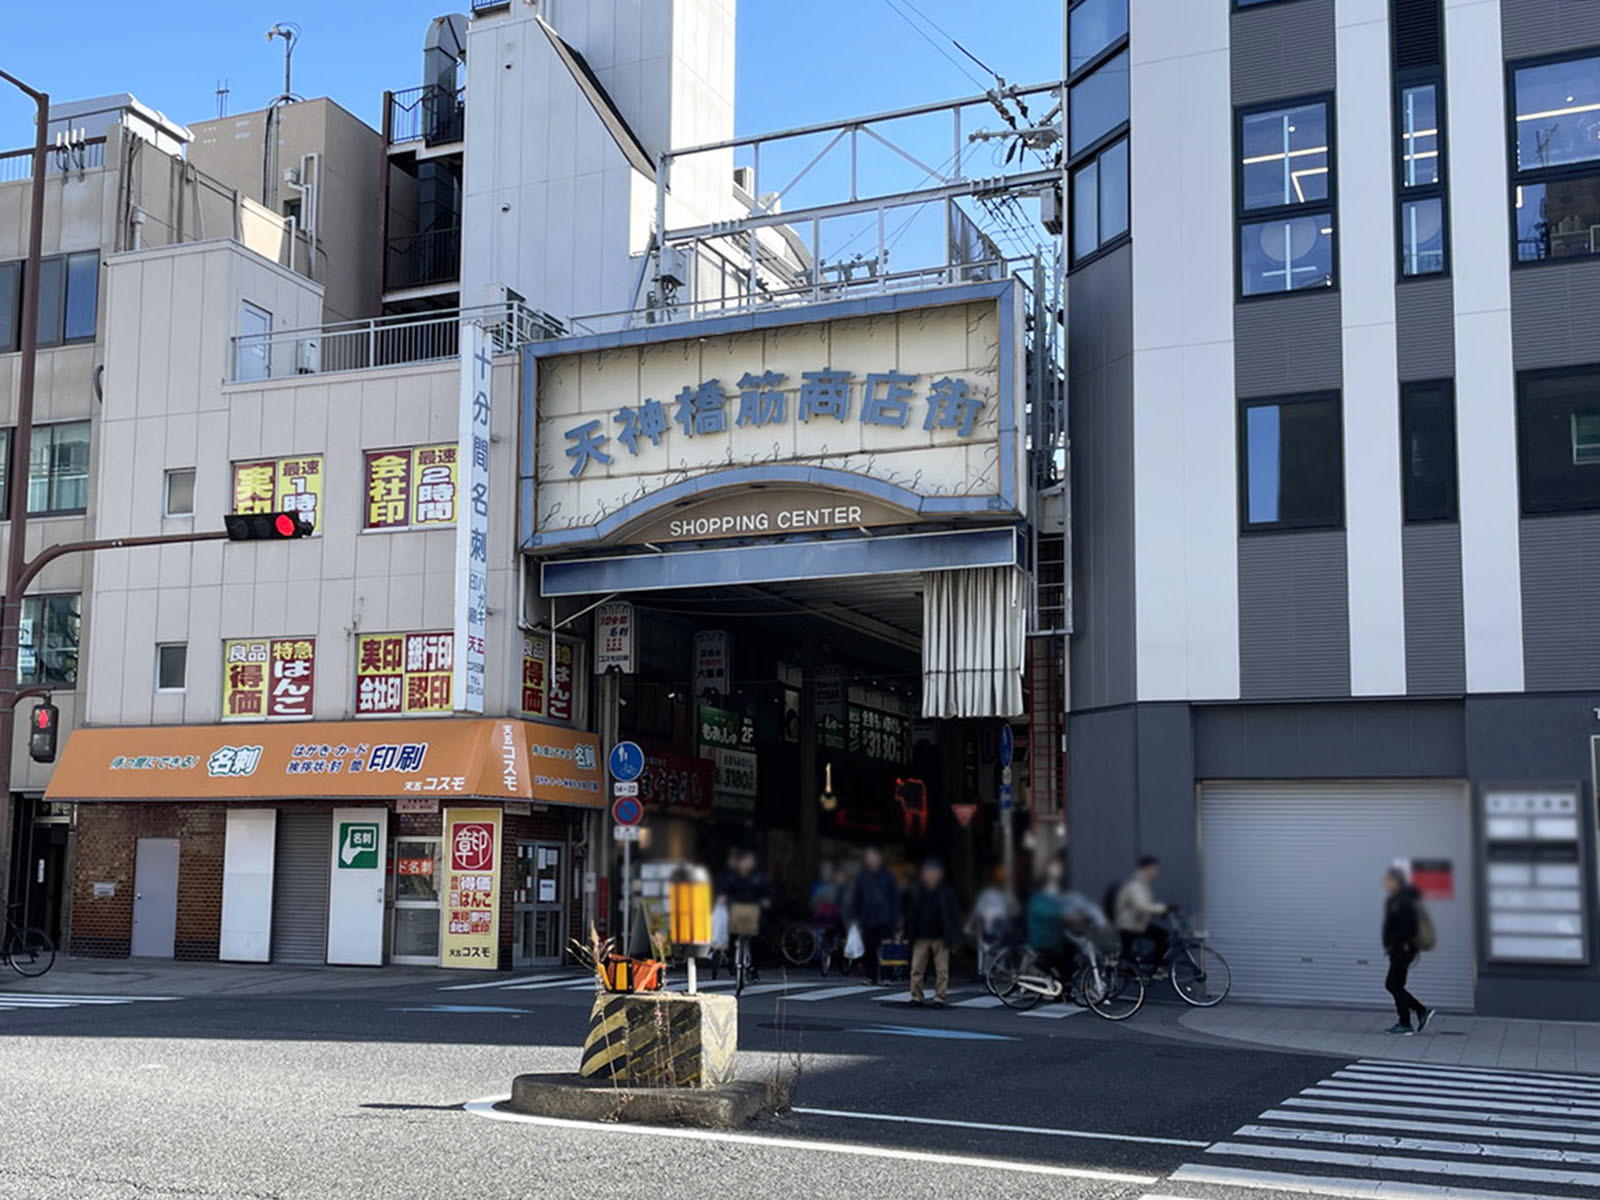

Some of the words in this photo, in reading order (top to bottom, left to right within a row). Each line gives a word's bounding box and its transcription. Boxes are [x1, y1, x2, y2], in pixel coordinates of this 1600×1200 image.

[564, 366, 986, 477] 天神橋筋商店街
[283, 460, 319, 476] 最速
[418, 448, 457, 465] 最速
[470, 347, 491, 563] 十分間名刺
[370, 455, 407, 523] 会社印
[417, 466, 455, 522] 2時間
[670, 511, 769, 537] SHOPPING
[777, 506, 862, 529] CENTER
[228, 643, 267, 663] 良品
[273, 641, 313, 660] 特急
[361, 639, 402, 672] 実印
[407, 636, 453, 670] 銀行印
[229, 665, 263, 714] 得価
[273, 660, 310, 713] はんこ
[360, 677, 401, 710] 会社印
[408, 675, 450, 710] 認印
[206, 745, 264, 777] 名刺
[366, 743, 428, 773] 印刷
[460, 892, 492, 907] はんこ
